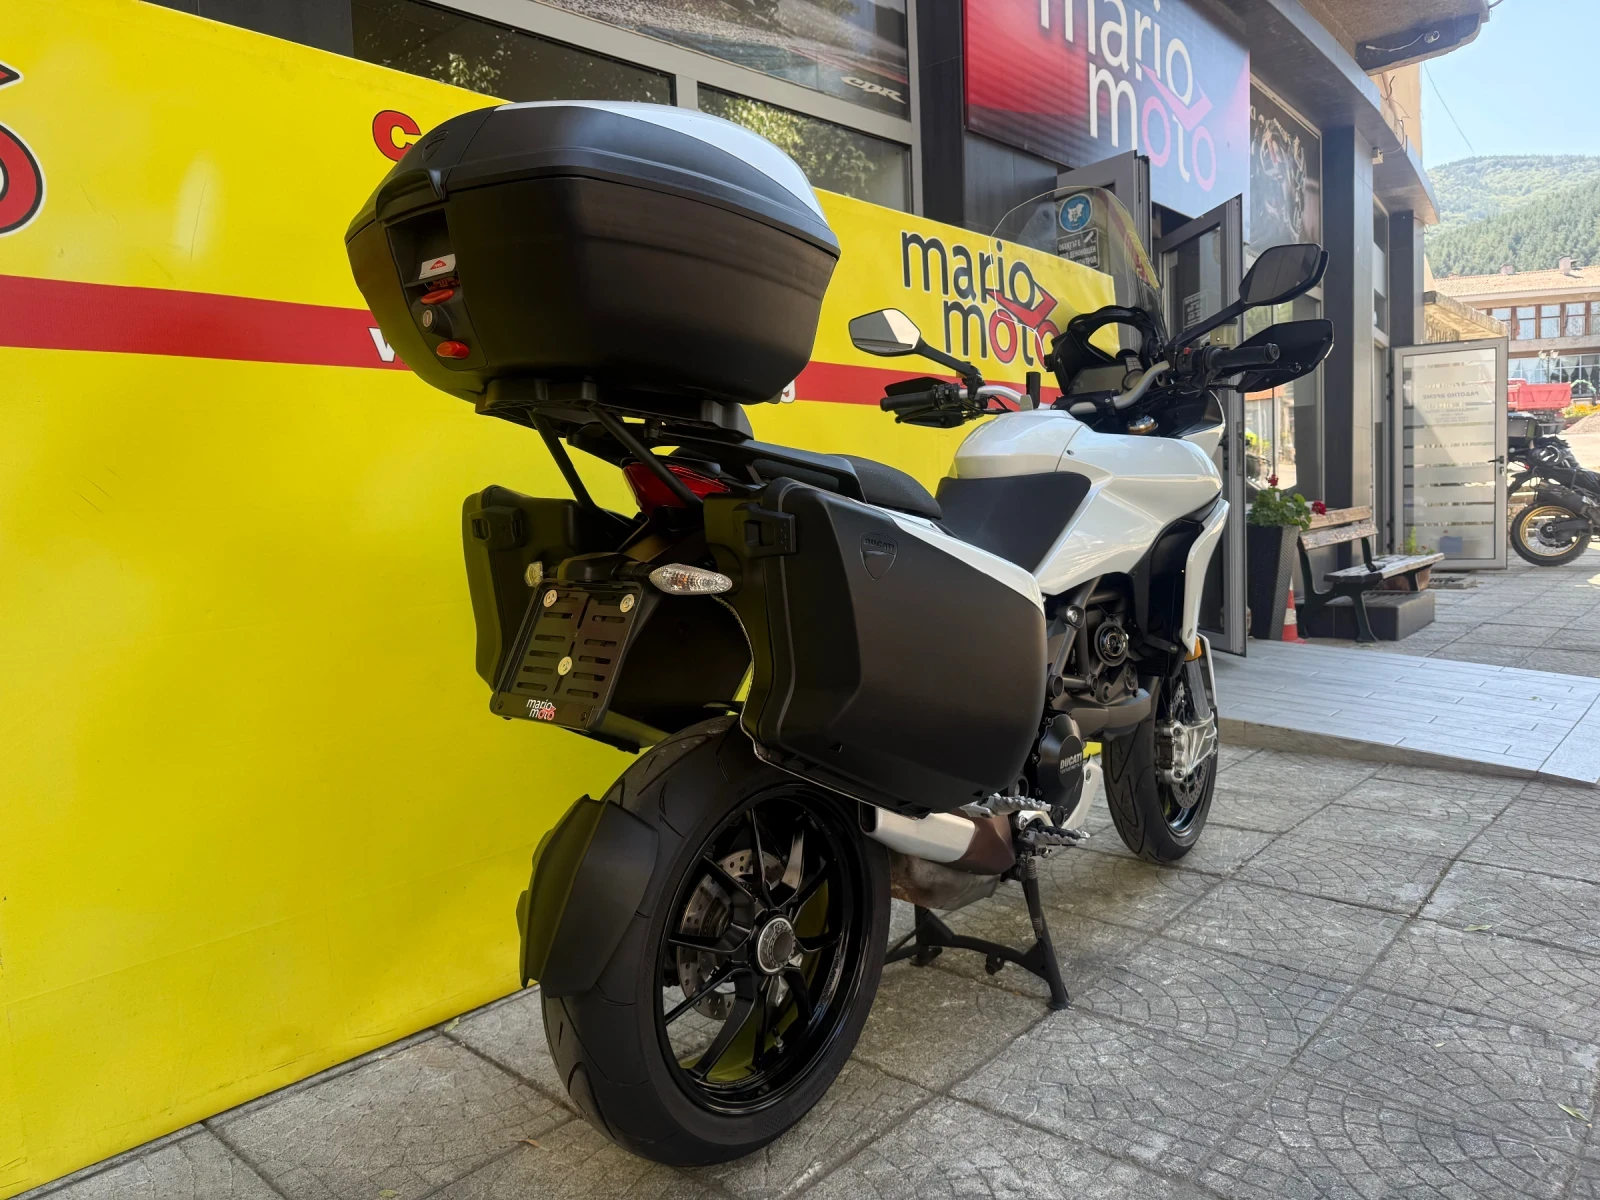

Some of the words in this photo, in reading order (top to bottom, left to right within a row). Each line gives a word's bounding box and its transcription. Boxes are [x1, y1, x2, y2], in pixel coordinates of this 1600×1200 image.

[841, 76, 906, 104] CBR
[1089, 62, 1217, 192] moto
[901, 231, 1036, 309] mario
[864, 538, 895, 551] DUCATI
[526, 699, 553, 710] mario
[529, 708, 555, 721] moto
[1060, 752, 1083, 769] DUCATI
